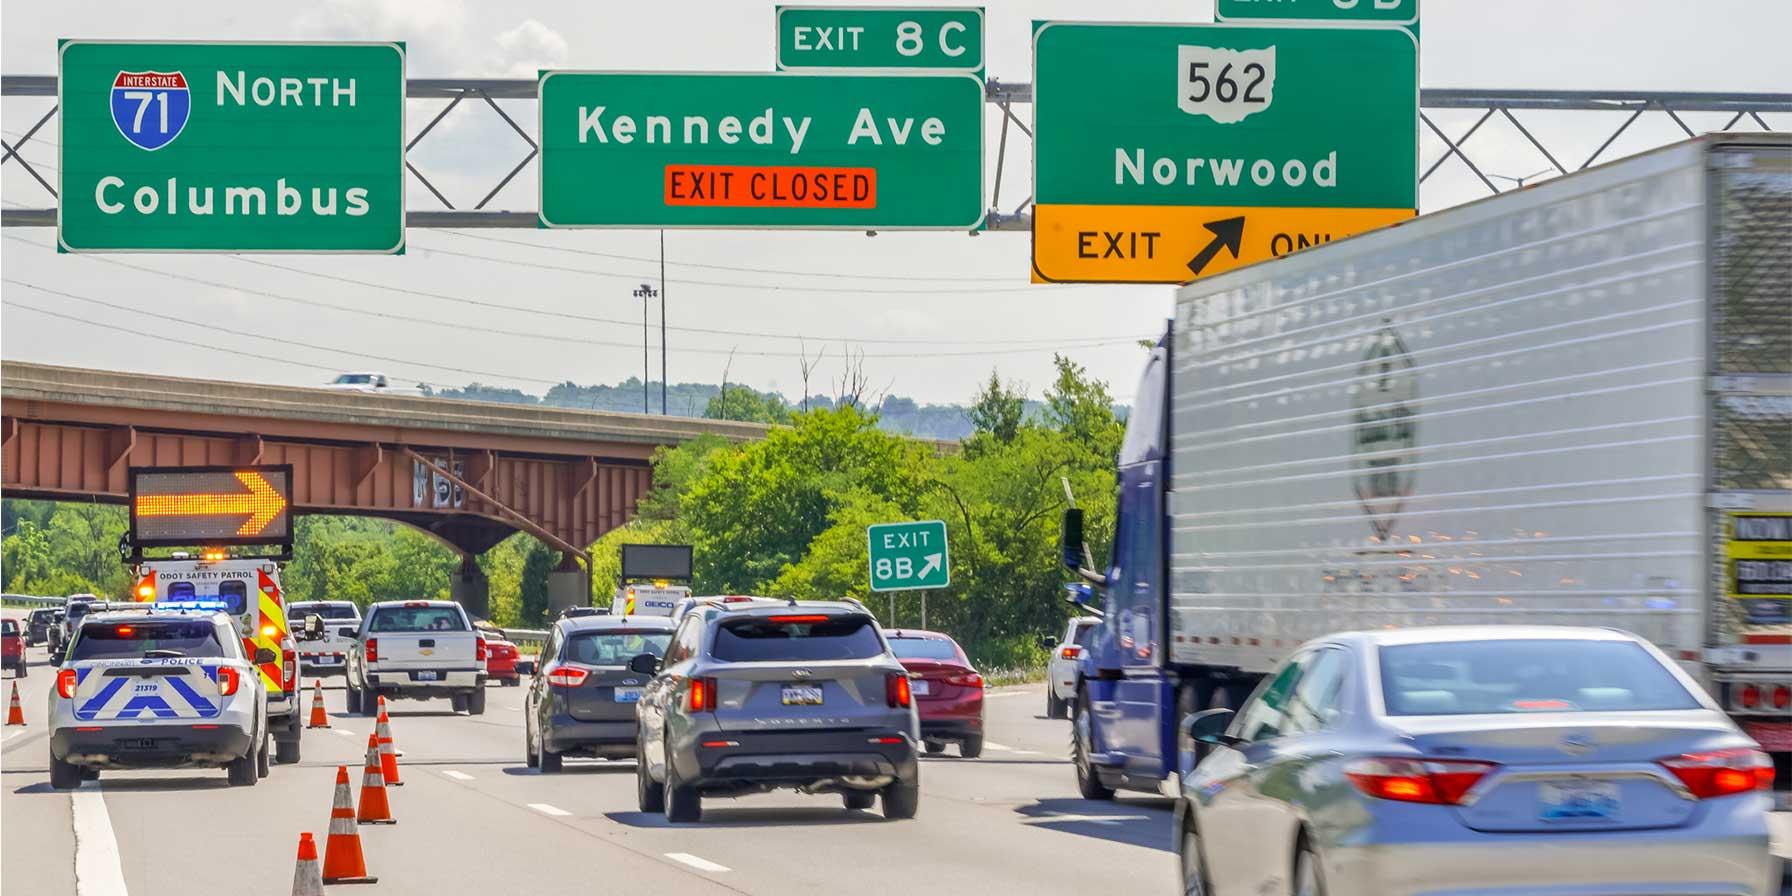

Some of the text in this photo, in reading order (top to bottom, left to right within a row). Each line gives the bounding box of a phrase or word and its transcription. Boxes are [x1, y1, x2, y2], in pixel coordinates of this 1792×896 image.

[794, 26, 865, 51] EXIT
[123, 76, 178, 87] INTERSTATE
[216, 70, 356, 107] NORTH
[1188, 61, 1267, 104] 562
[124, 91, 168, 134] 71
[578, 106, 946, 154] Kennedy Ave
[1115, 147, 1337, 187] Norwood
[95, 175, 370, 216] Columbus
[671, 171, 869, 201] EXIT CLOSED
[1078, 231, 1161, 259] EXIT
[883, 531, 930, 549] EXIT
[160, 571, 253, 580] ODOT SAFETY PATROL
[876, 557, 913, 580] 8B
[645, 600, 674, 608] GEICO
